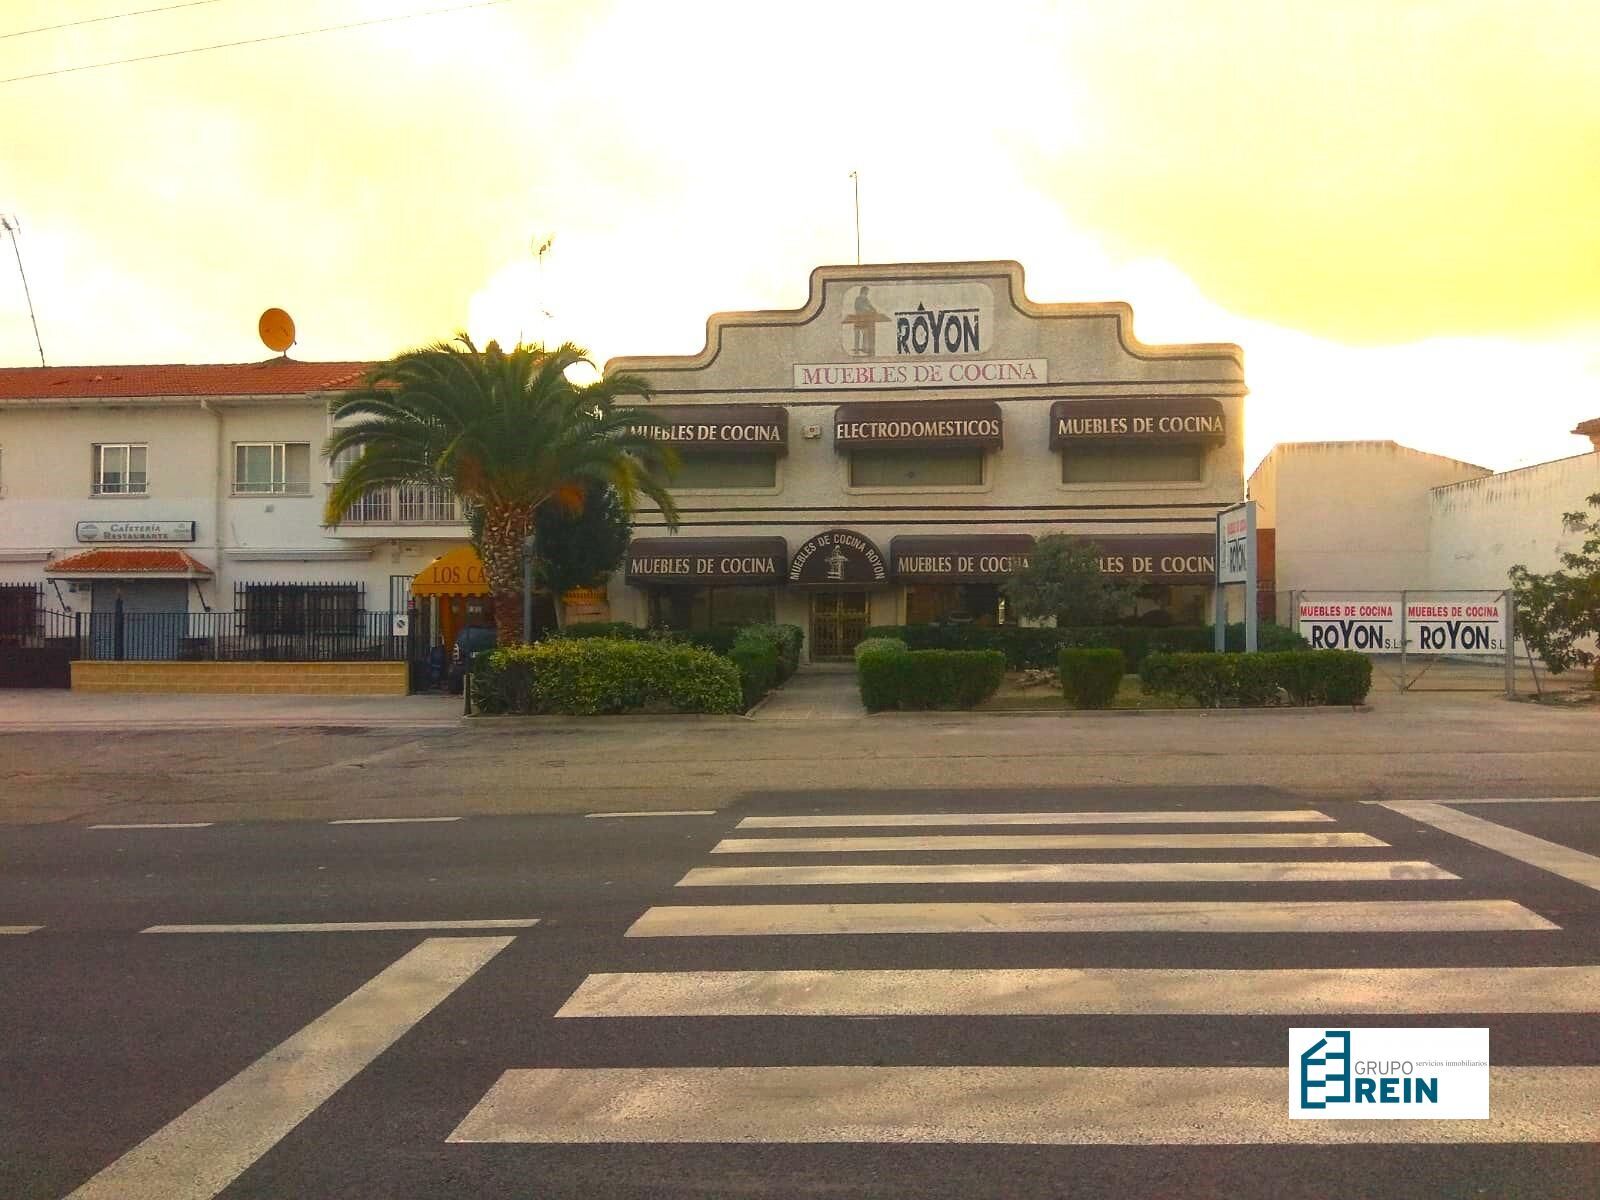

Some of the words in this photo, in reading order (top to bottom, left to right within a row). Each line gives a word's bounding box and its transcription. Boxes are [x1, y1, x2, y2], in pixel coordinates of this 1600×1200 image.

[897, 310, 980, 355] ROYON
[802, 365, 907, 385] MUEBLES
[912, 365, 943, 383] DE
[949, 362, 1037, 382] COCINA
[698, 425, 717, 440] DE
[720, 424, 780, 441] COCINA
[836, 420, 999, 439] ELECTRODOMESTICOS
[1058, 417, 1128, 434] MUEBLES
[1133, 417, 1153, 433] DE
[1158, 416, 1223, 433] COCINA
[631, 558, 689, 574] MUEBLES
[696, 558, 714, 574] DE
[720, 557, 775, 574] COCINA
[789, 542, 817, 580] MUEBLES
[818, 535, 831, 546] DE
[833, 534, 866, 552] COCINA
[865, 549, 885, 580] ROYON
[898, 557, 952, 573] MUEBLES
[958, 557, 974, 573] DE
[1132, 557, 1153, 573] DE
[1161, 556, 1215, 573] COCIN
[432, 566, 460, 584] LOS
[1300, 606, 1341, 617] MUEBLES
[1344, 606, 1357, 617] DE
[1360, 606, 1393, 617] COCINA
[1408, 606, 1449, 617] MUEBLES
[1451, 606, 1462, 617] DE
[1466, 606, 1499, 617] COCINA
[1312, 620, 1383, 649] ROYON
[1420, 621, 1490, 649] ROYON
